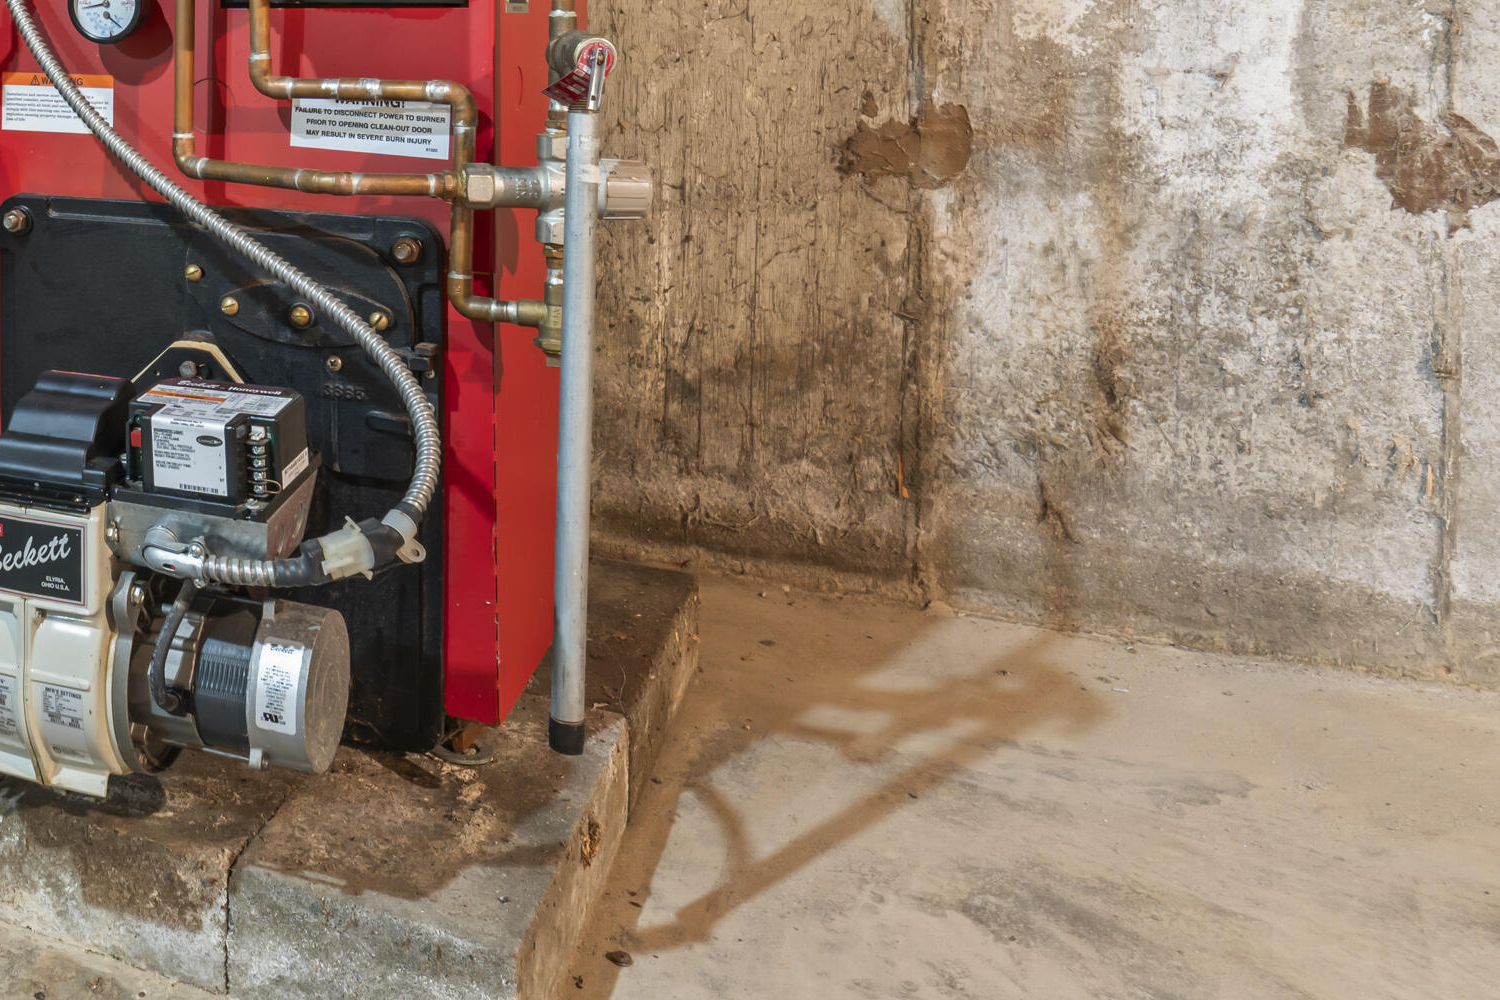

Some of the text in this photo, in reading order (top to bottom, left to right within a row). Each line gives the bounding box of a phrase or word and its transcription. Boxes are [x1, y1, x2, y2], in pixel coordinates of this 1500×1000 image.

[295, 106, 322, 115] FAILURE
[334, 109, 377, 118] DISCONNECT
[379, 112, 404, 120] POWER
[416, 115, 445, 124] BURNER
[306, 118, 326, 126] PRIOR
[338, 121, 369, 129] OPENING
[370, 123, 410, 132] CLEAN-OUT
[411, 126, 432, 134] DOOR
[321, 130, 347, 138] RESULT
[357, 133, 384, 141] SEVERE
[385, 135, 405, 143] BURN
[407, 136, 432, 145] INJURY
[228, 386, 282, 395] Honeywell
[41, 581, 70, 592] OHIO U.S.A.
